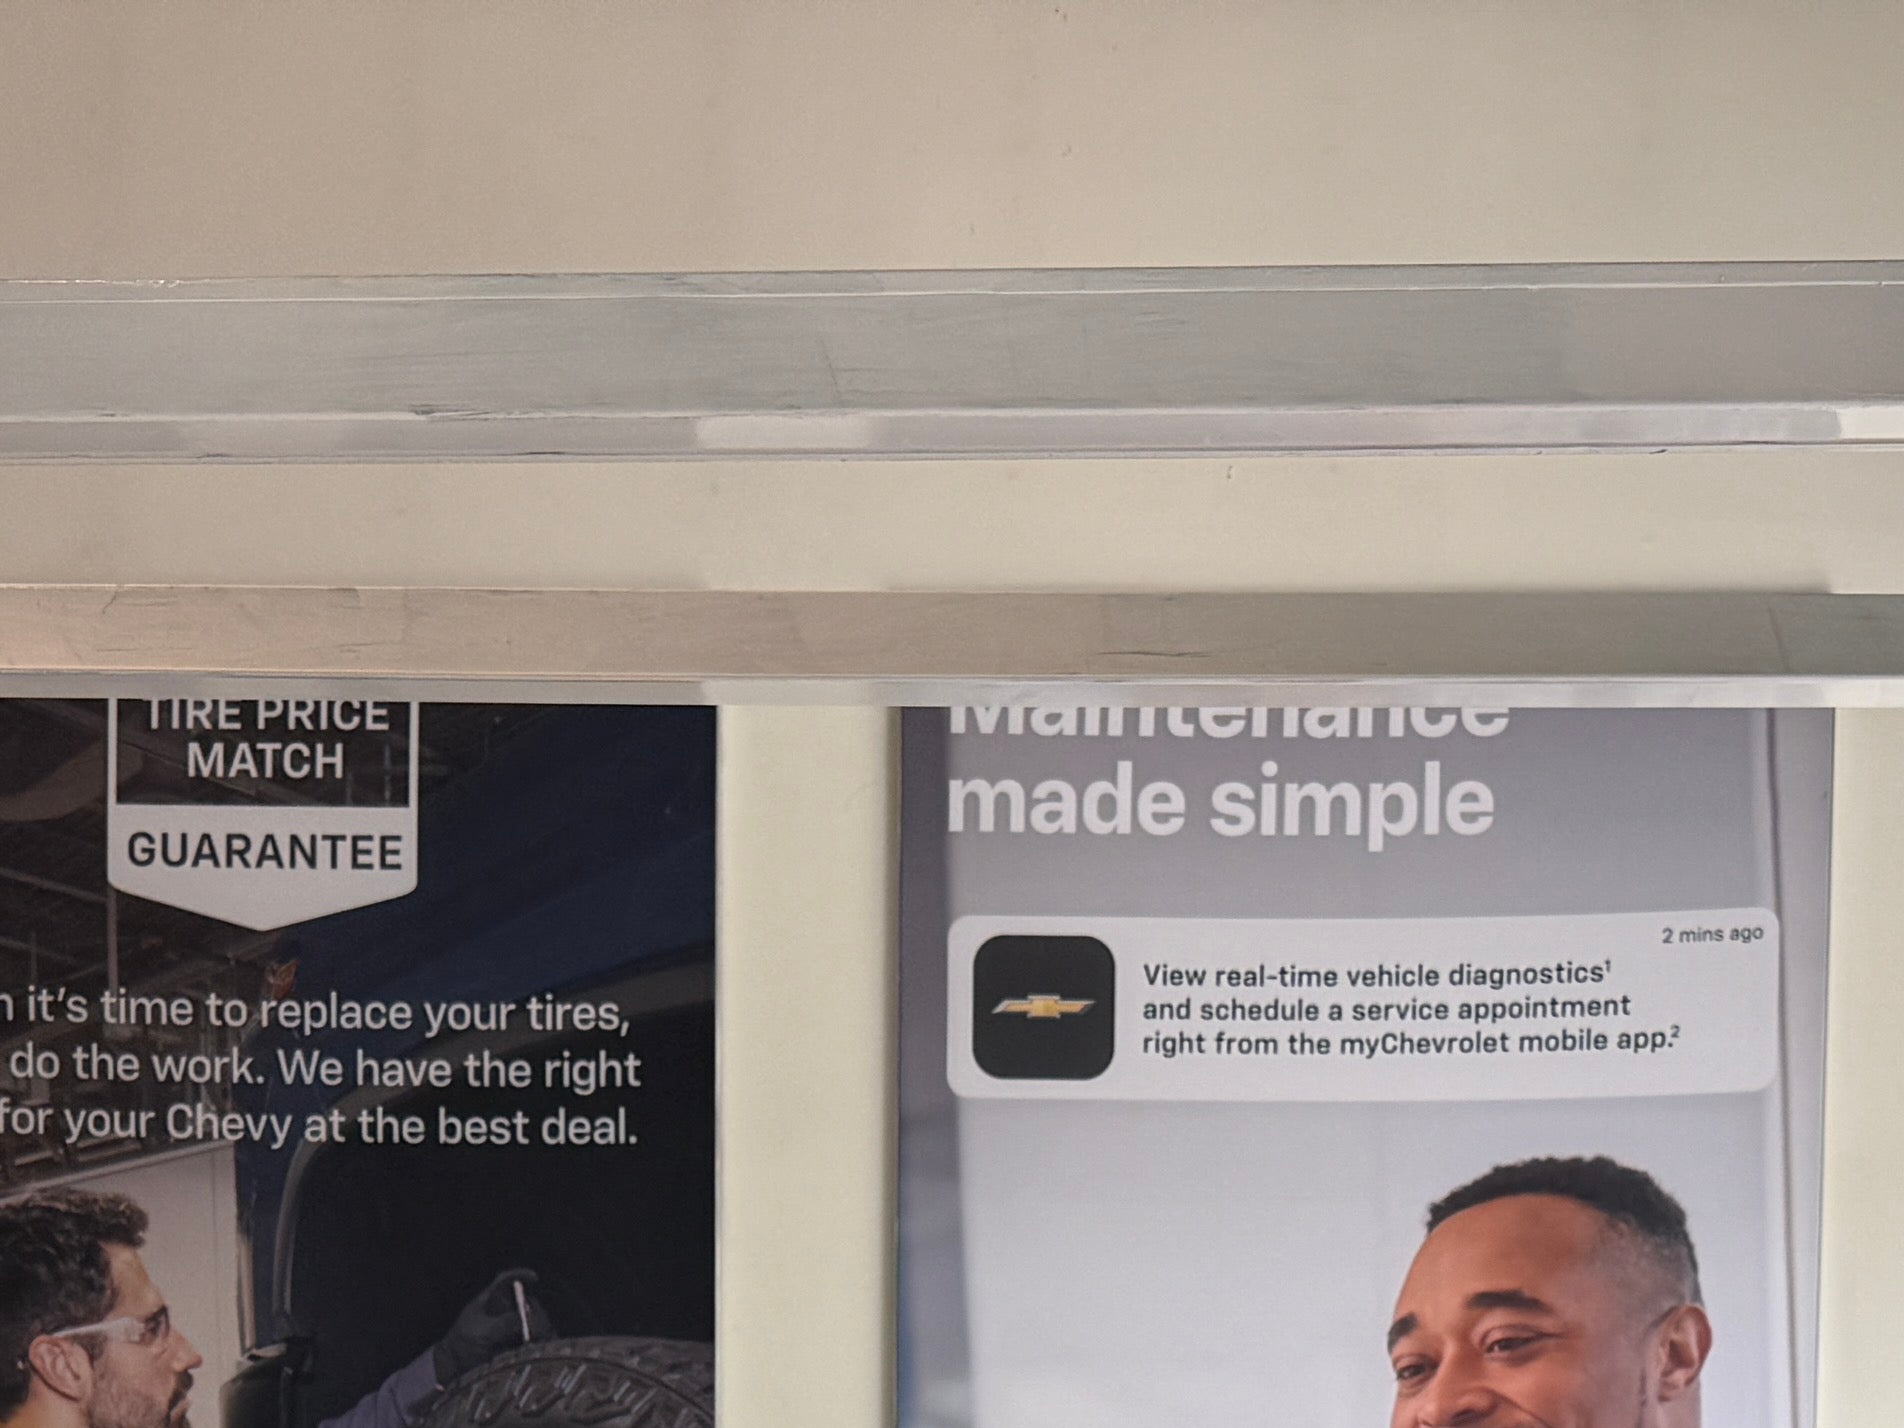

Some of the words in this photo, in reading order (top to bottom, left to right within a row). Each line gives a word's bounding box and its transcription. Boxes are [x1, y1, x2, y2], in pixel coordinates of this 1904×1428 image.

[148, 698, 241, 730] TIRE
[257, 698, 389, 731] PRICE
[188, 742, 342, 778] MATCH
[950, 761, 1185, 836] made
[1210, 761, 1494, 852] simple
[128, 832, 402, 870] GUARANTEE
[1663, 928, 1673, 943] 2
[1679, 928, 1724, 942] mins
[1730, 927, 1763, 943] ago
[1144, 964, 1206, 986] View
[1216, 964, 1337, 987] real-time
[1347, 964, 1439, 987] vehicle
[29, 985, 88, 1022] it's
[100, 988, 193, 1025] time
[205, 993, 247, 1026] to
[261, 991, 411, 1035] replace
[424, 1003, 516, 1037] your
[527, 994, 628, 1036] tires,
[1144, 998, 1190, 1019] and
[1201, 998, 1319, 1021] schedule
[1329, 1004, 1342, 1021] a
[1353, 998, 1449, 1021] service
[1458, 995, 1630, 1026] appointment
[1144, 1031, 1205, 1058] right
[1215, 1031, 1278, 1054] from
[1288, 1033, 1330, 1054] the
[1341, 1031, 1509, 1059] myChevrolet
[1519, 1028, 1607, 1052] mobile
[10, 1041, 59, 1079] do
[72, 1043, 139, 1081] the
[152, 1046, 264, 1083] work.
[278, 1049, 342, 1085] We
[357, 1049, 451, 1087] have
[464, 1049, 531, 1087] the
[546, 1050, 641, 1095] right
[64, 1109, 155, 1144] your
[167, 1102, 292, 1148] Chevy
[305, 1109, 345, 1142] at
[358, 1106, 424, 1143] the
[439, 1107, 529, 1144] best
[542, 1107, 637, 1144] deal.
